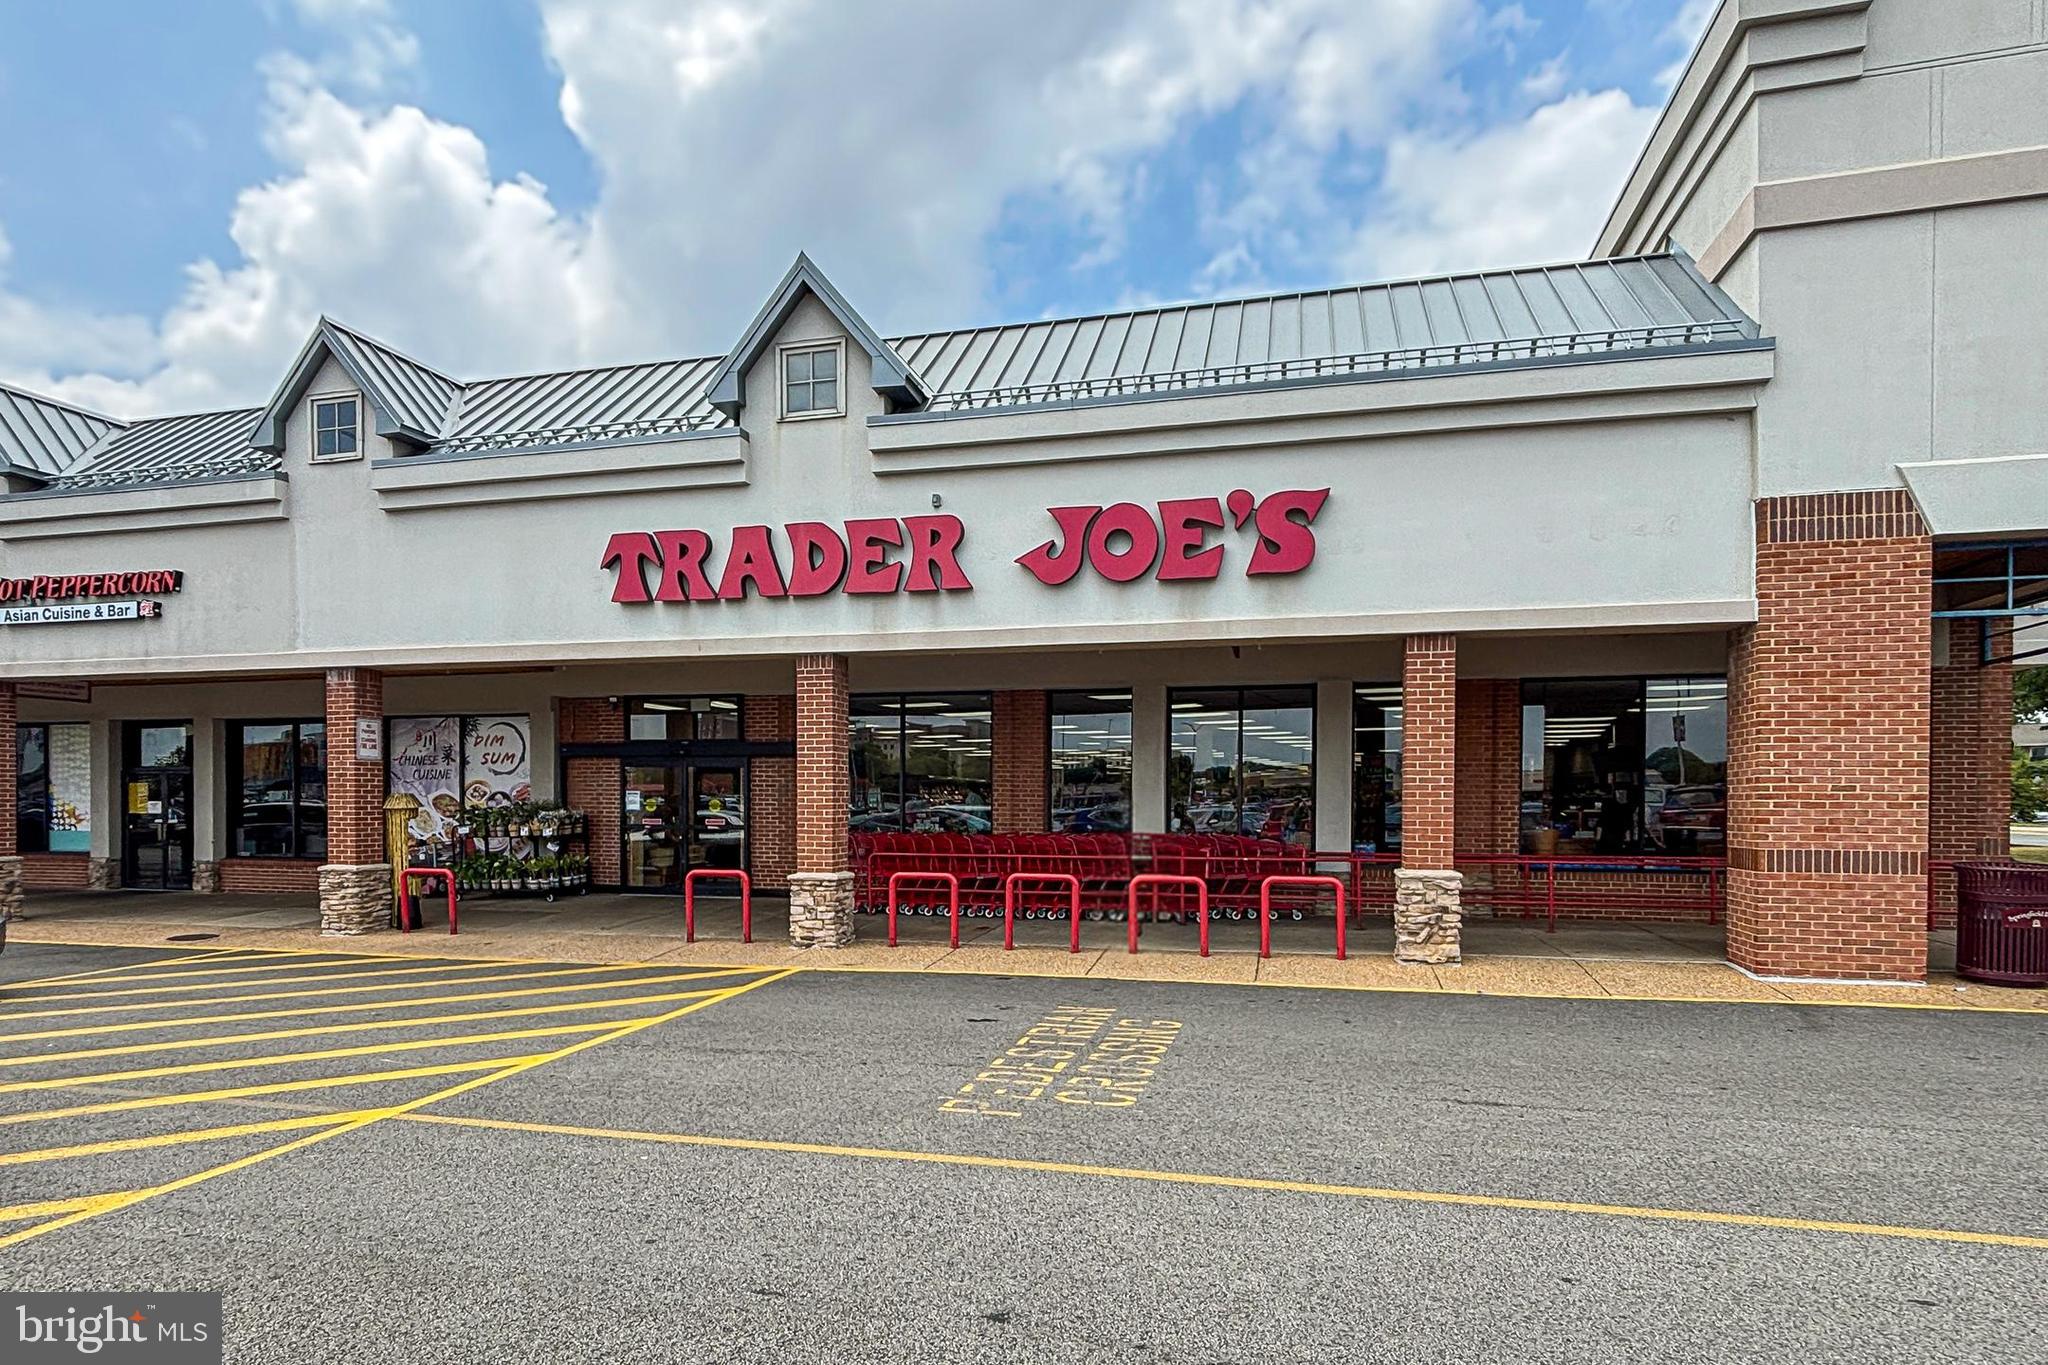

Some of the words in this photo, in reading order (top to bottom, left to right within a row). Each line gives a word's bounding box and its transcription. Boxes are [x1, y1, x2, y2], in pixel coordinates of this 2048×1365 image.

[600, 514, 974, 603] TRADER
[1013, 487, 1331, 585] JOE'S
[0, 579, 27, 600] OT
[32, 571, 176, 599] PEPPERCORN
[4, 609, 39, 623] Asian
[42, 606, 91, 622] Cuisine
[94, 605, 104, 618] &
[107, 604, 131, 617] Bar
[473, 735, 505, 747] DIM
[399, 755, 440, 767] CHINESE
[480, 752, 516, 766] SUM
[413, 769, 453, 781] CUISINE
